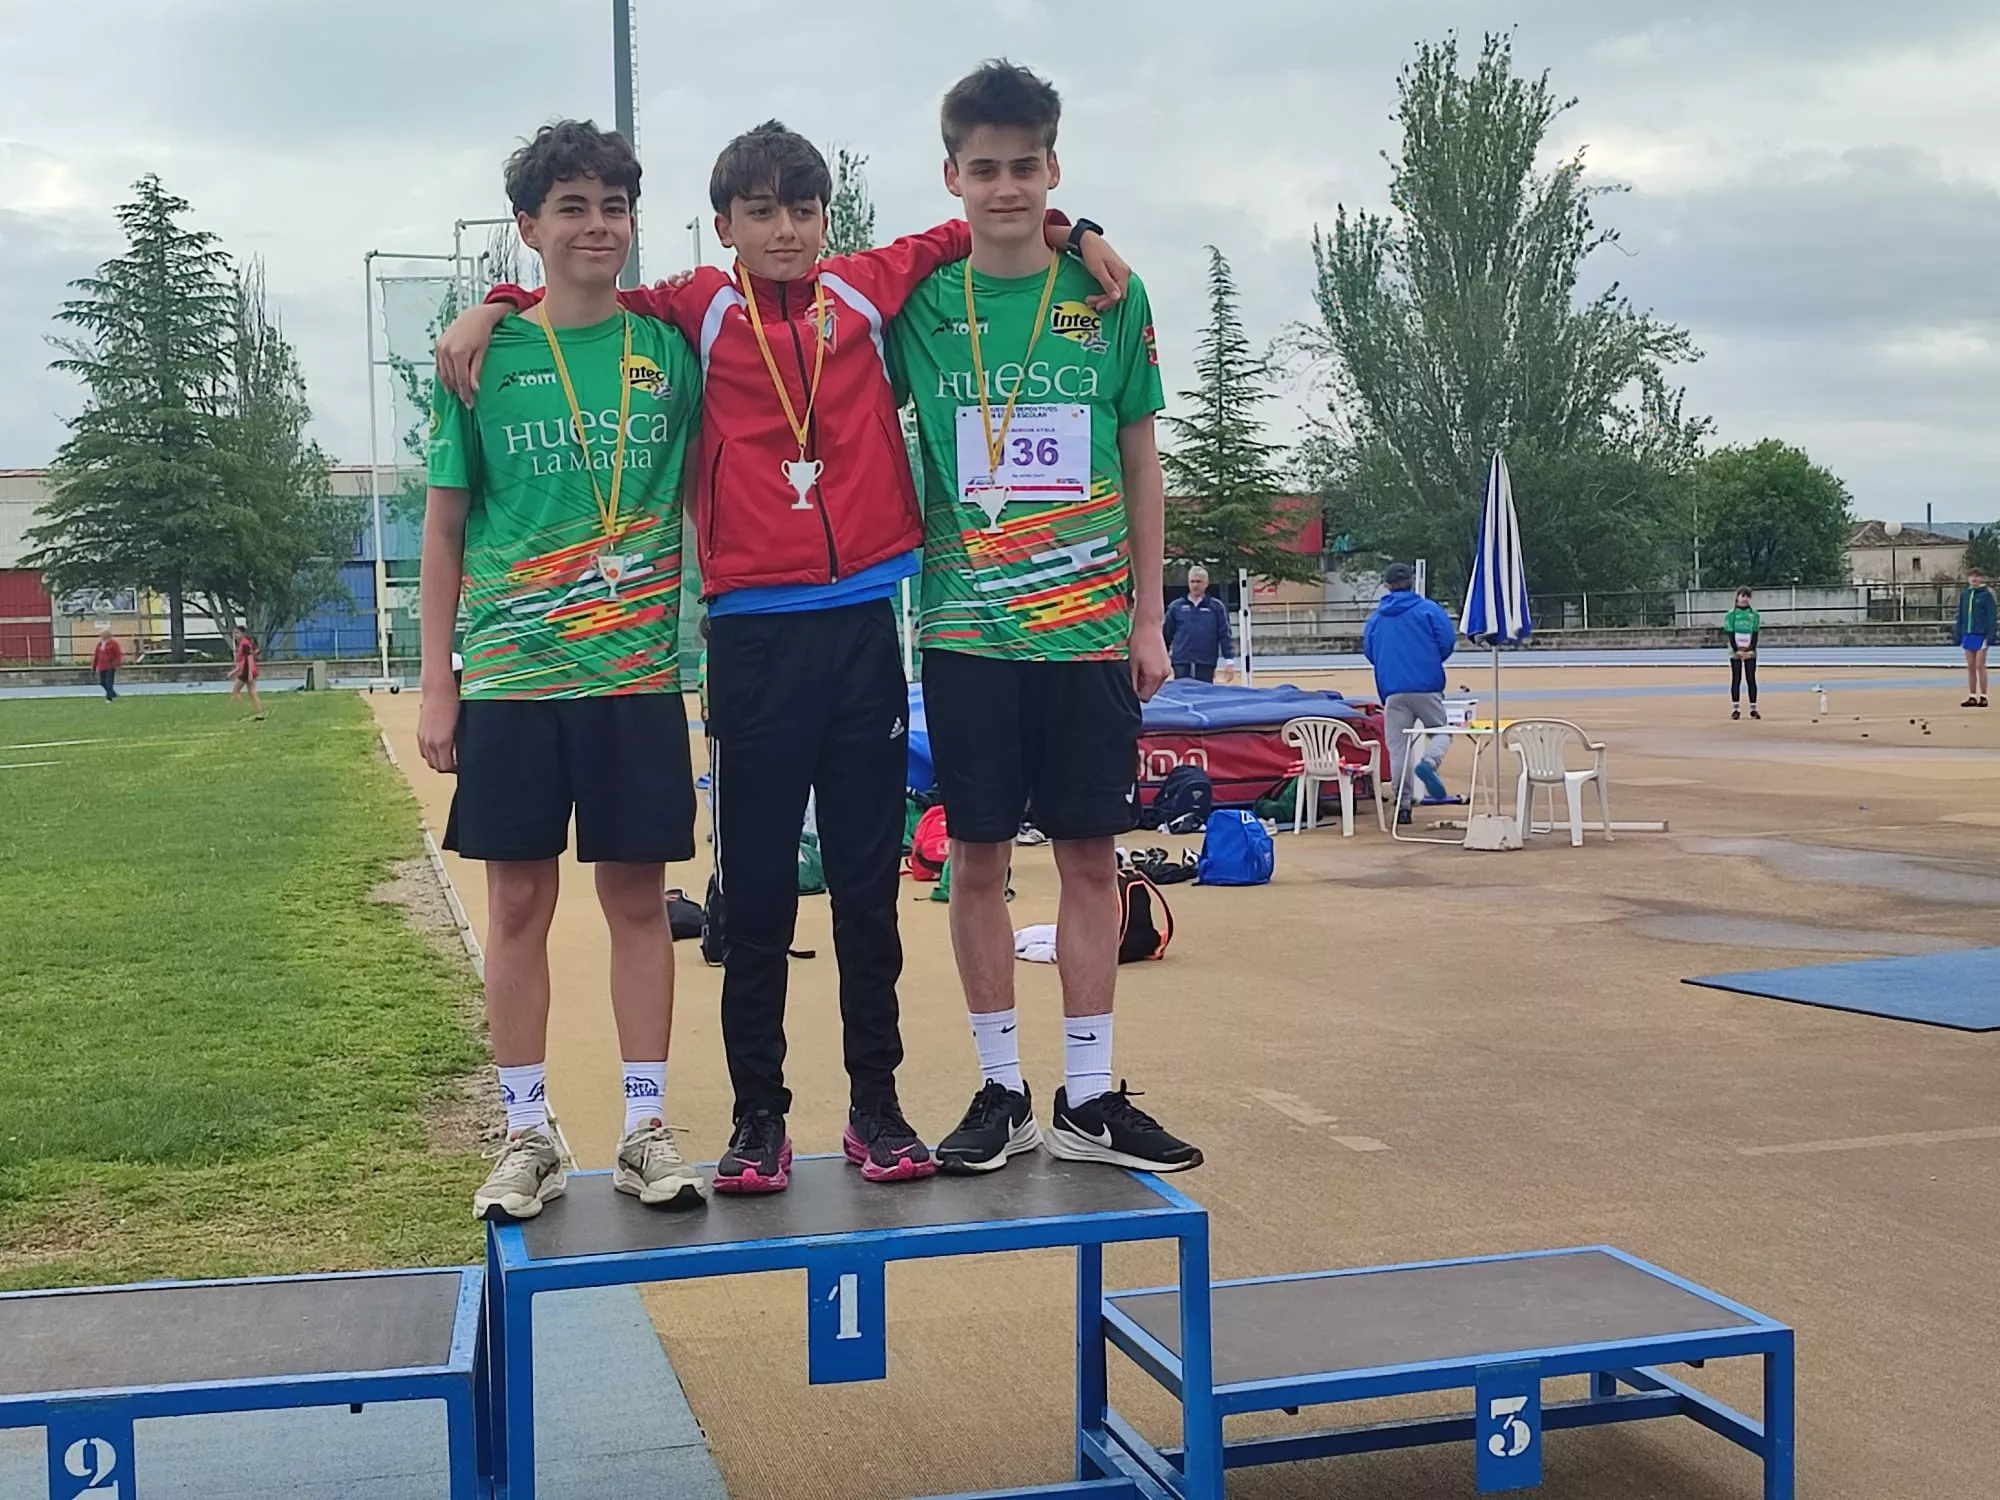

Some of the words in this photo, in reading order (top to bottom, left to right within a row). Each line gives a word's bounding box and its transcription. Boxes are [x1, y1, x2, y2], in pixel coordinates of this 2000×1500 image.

[620, 357, 665, 382] ntec
[532, 453, 563, 476] La
[828, 1273, 862, 1340] 1
[1488, 1396, 1531, 1457] 3
[64, 1437, 119, 1500] 2
